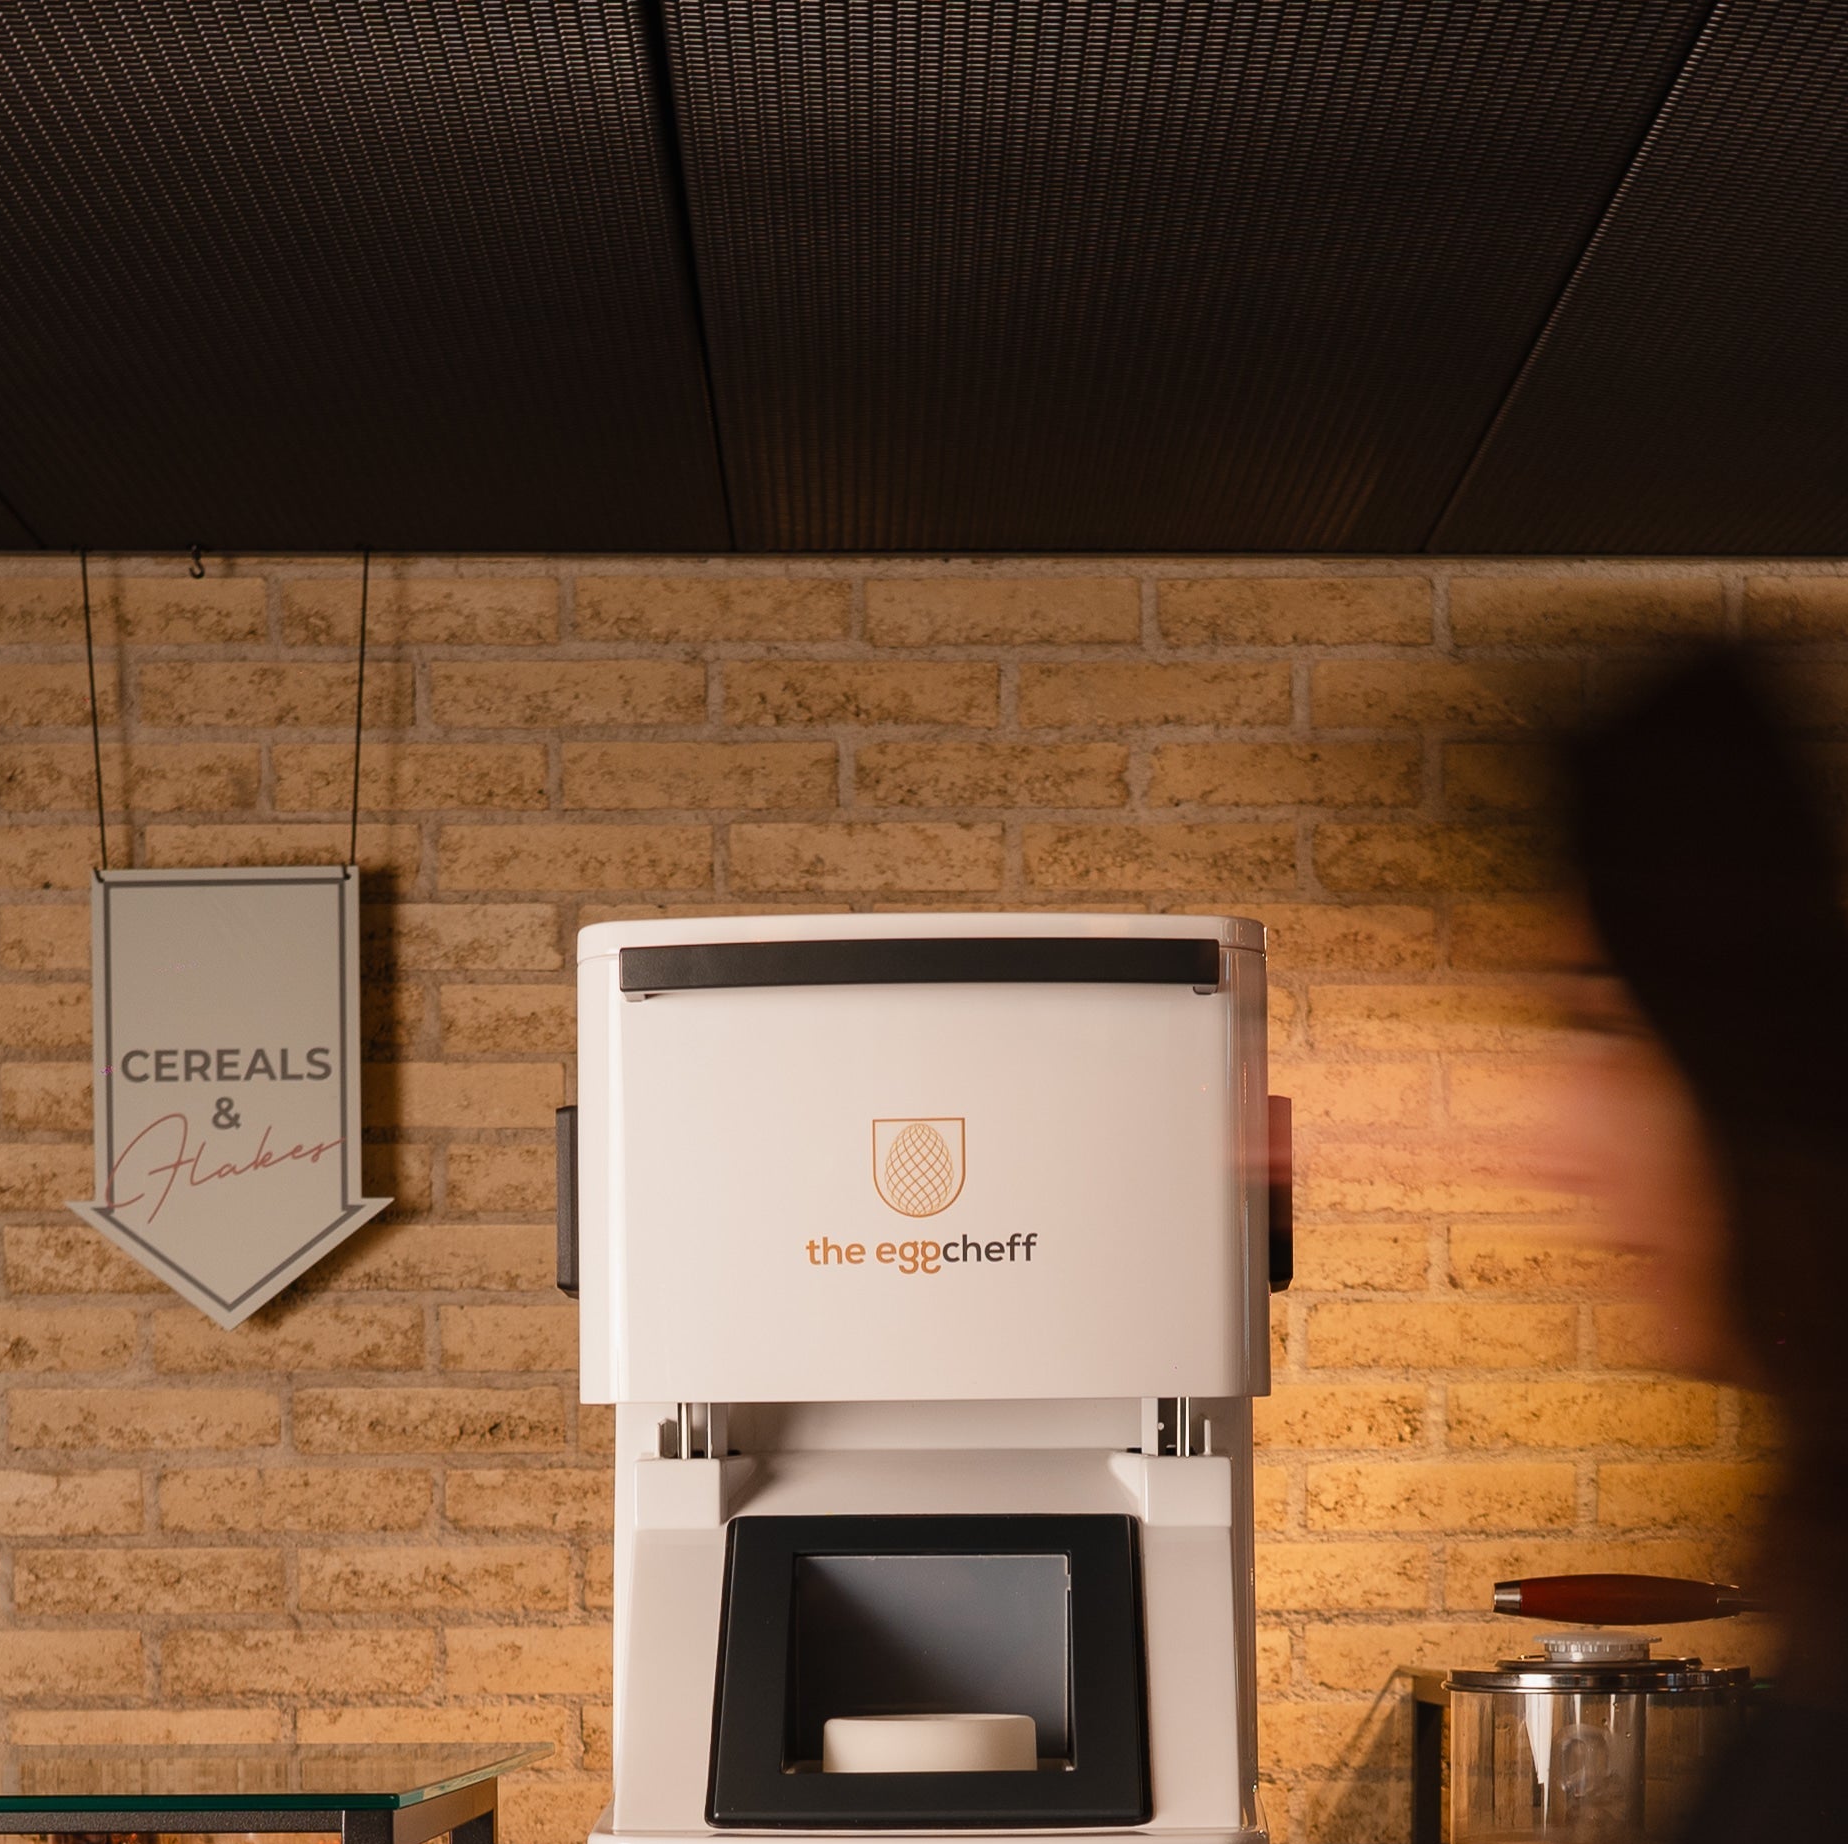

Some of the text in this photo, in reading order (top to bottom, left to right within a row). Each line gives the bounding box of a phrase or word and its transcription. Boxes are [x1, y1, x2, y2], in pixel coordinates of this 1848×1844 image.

[121, 1047, 333, 1083] CEREALS
[212, 1096, 242, 1131] &
[105, 1112, 346, 1226] Flakes
[806, 1233, 1038, 1275] the eggcheff
